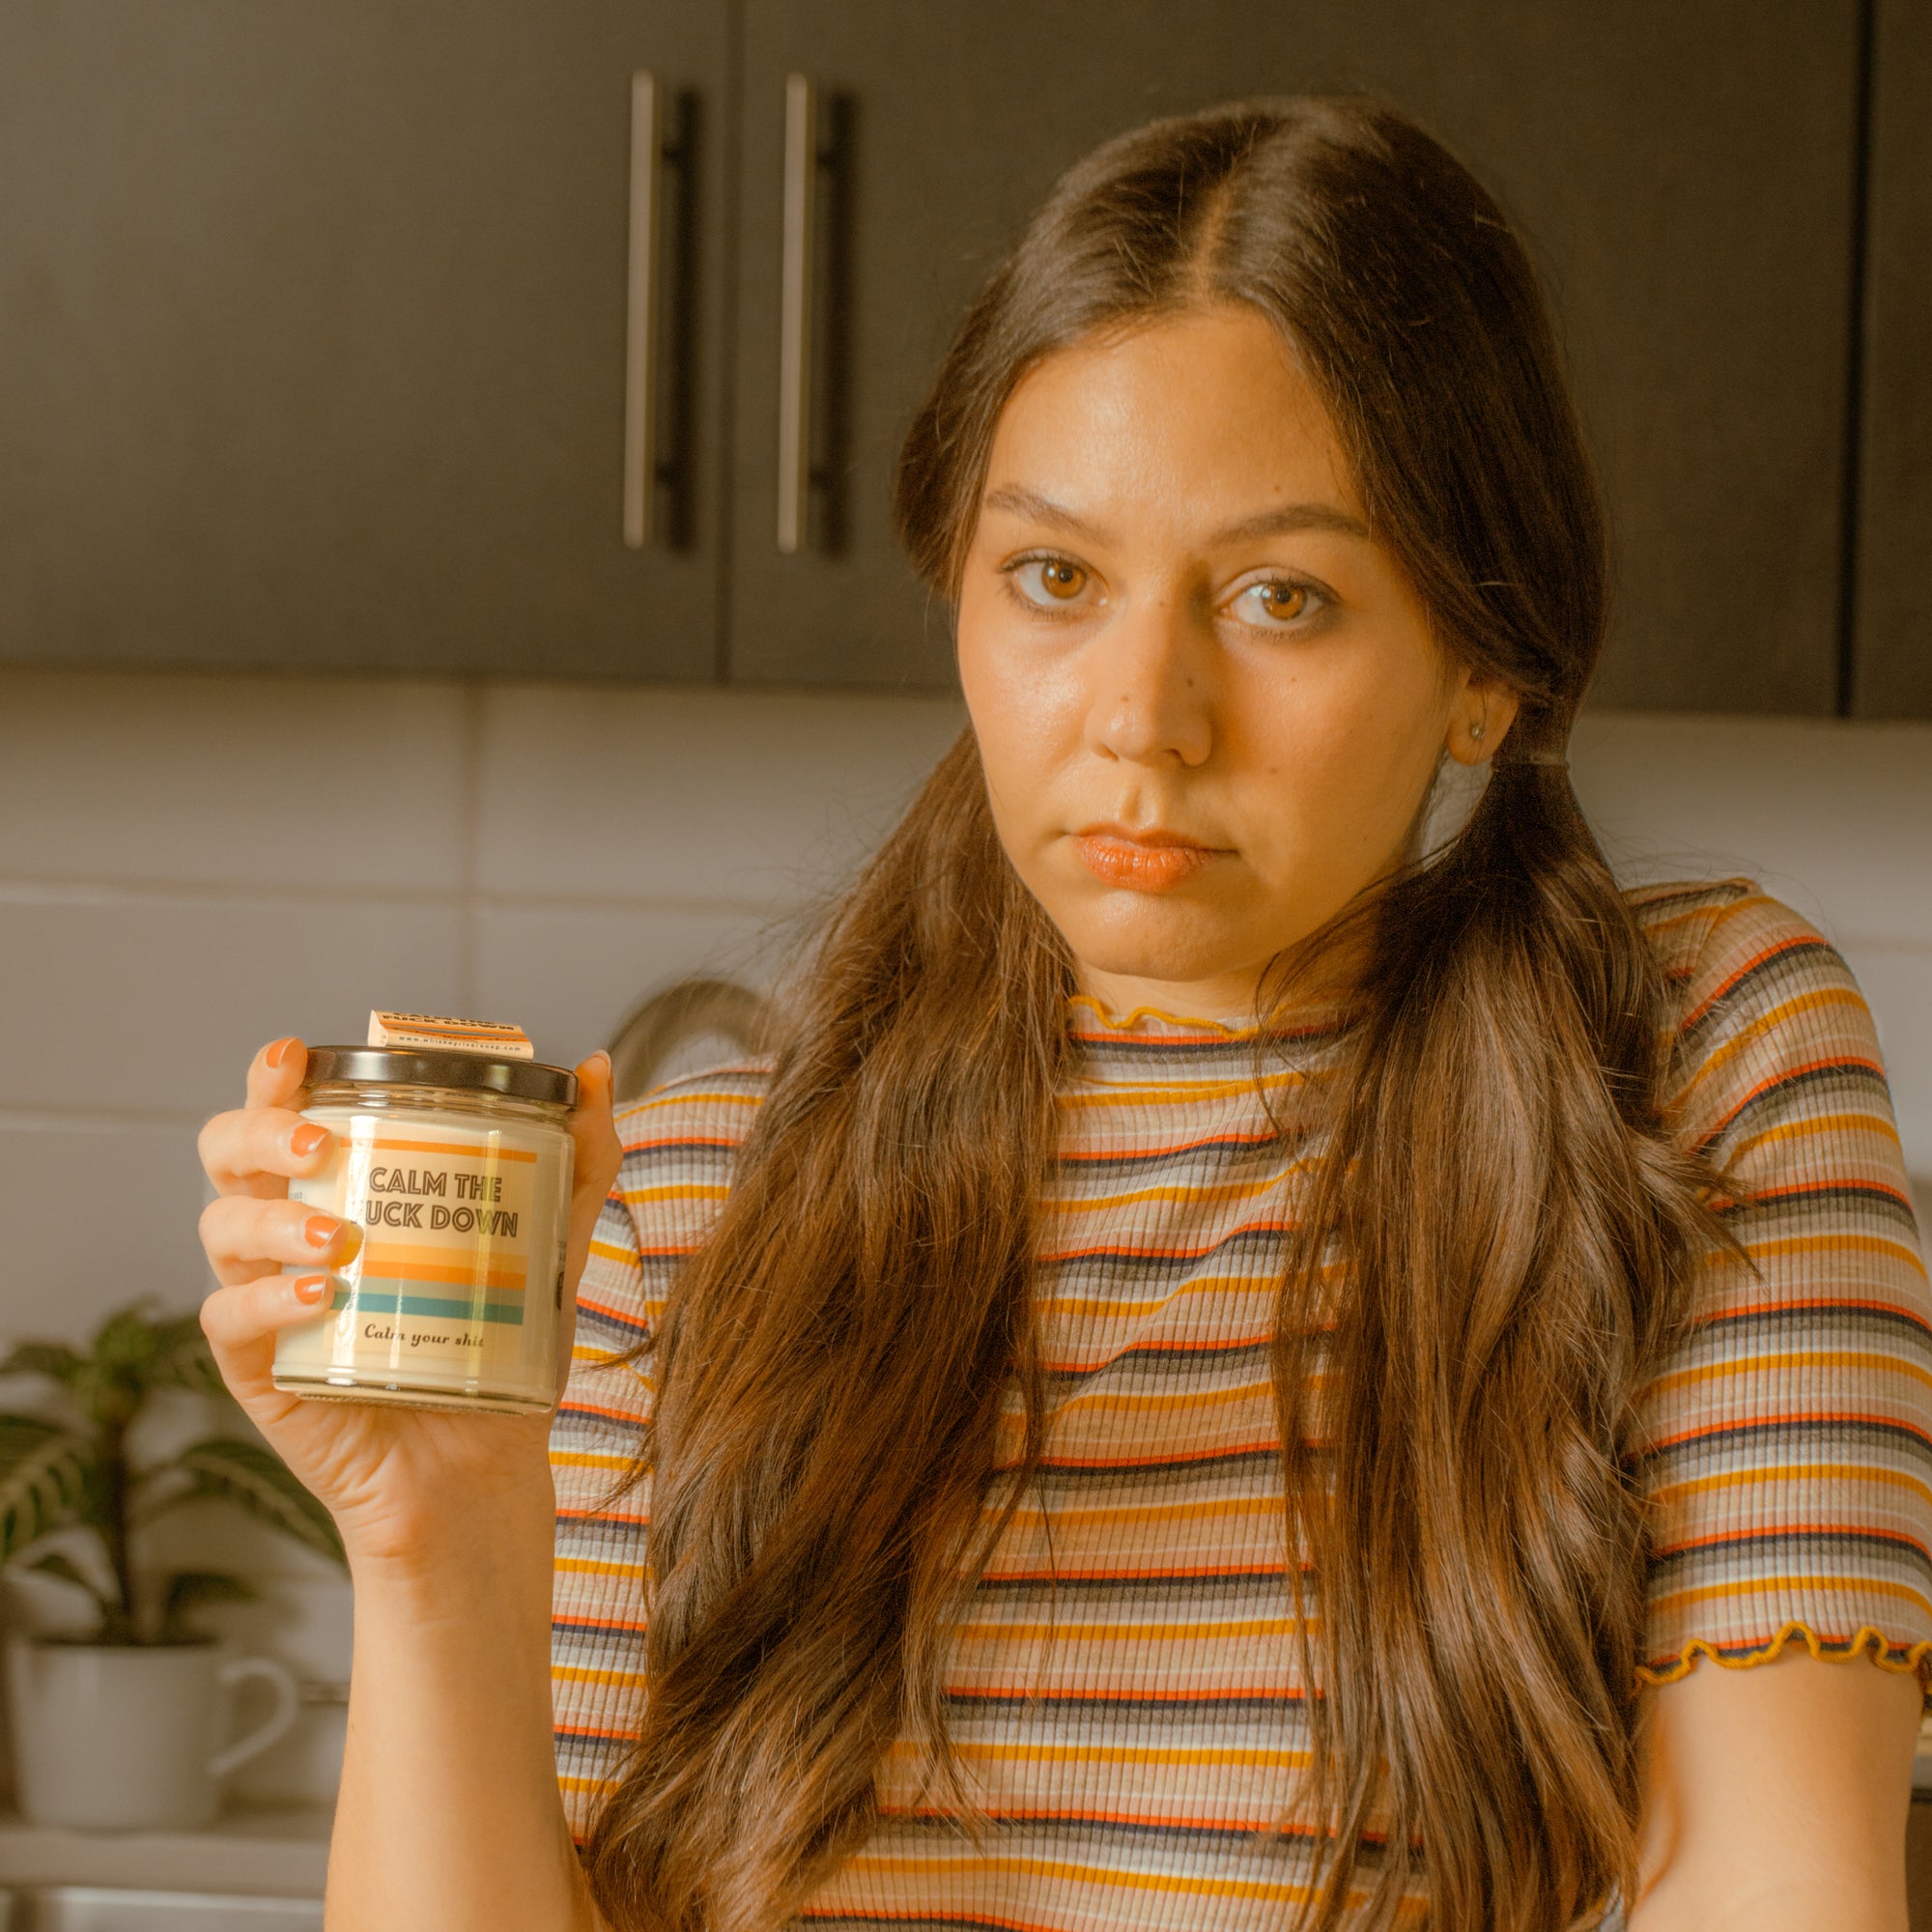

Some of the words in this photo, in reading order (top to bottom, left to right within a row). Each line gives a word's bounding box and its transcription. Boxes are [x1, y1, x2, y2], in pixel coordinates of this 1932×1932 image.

[369, 1167, 447, 1197] CALM
[454, 1173, 502, 1203] THE
[351, 1199, 425, 1229] UCK
[431, 1204, 519, 1237] DOWN
[364, 1323, 407, 1341] Calm
[411, 1332, 450, 1348] your
[455, 1334, 485, 1348] shit
